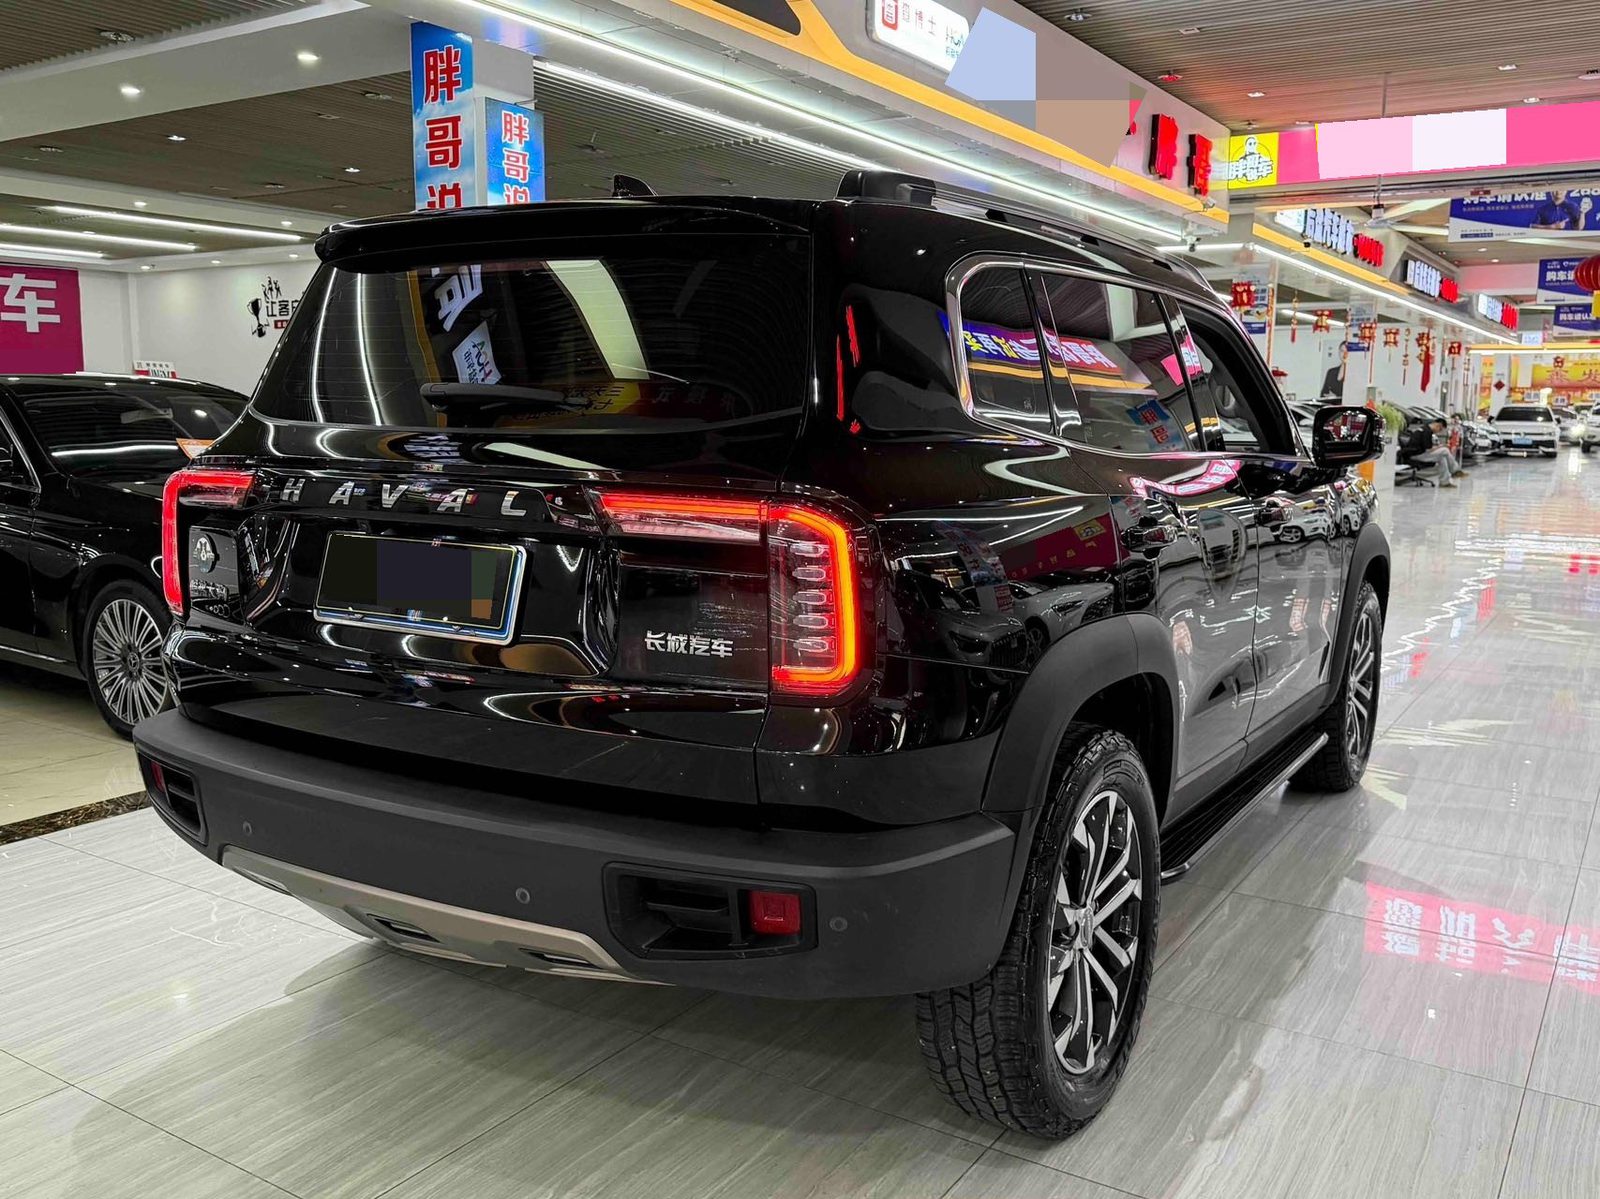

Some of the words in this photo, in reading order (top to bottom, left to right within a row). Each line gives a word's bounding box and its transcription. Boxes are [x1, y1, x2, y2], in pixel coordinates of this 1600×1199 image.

[0, 273, 60, 333] 车
[279, 478, 527, 517] HAVAL
[644, 630, 734, 658] 长城汽车
